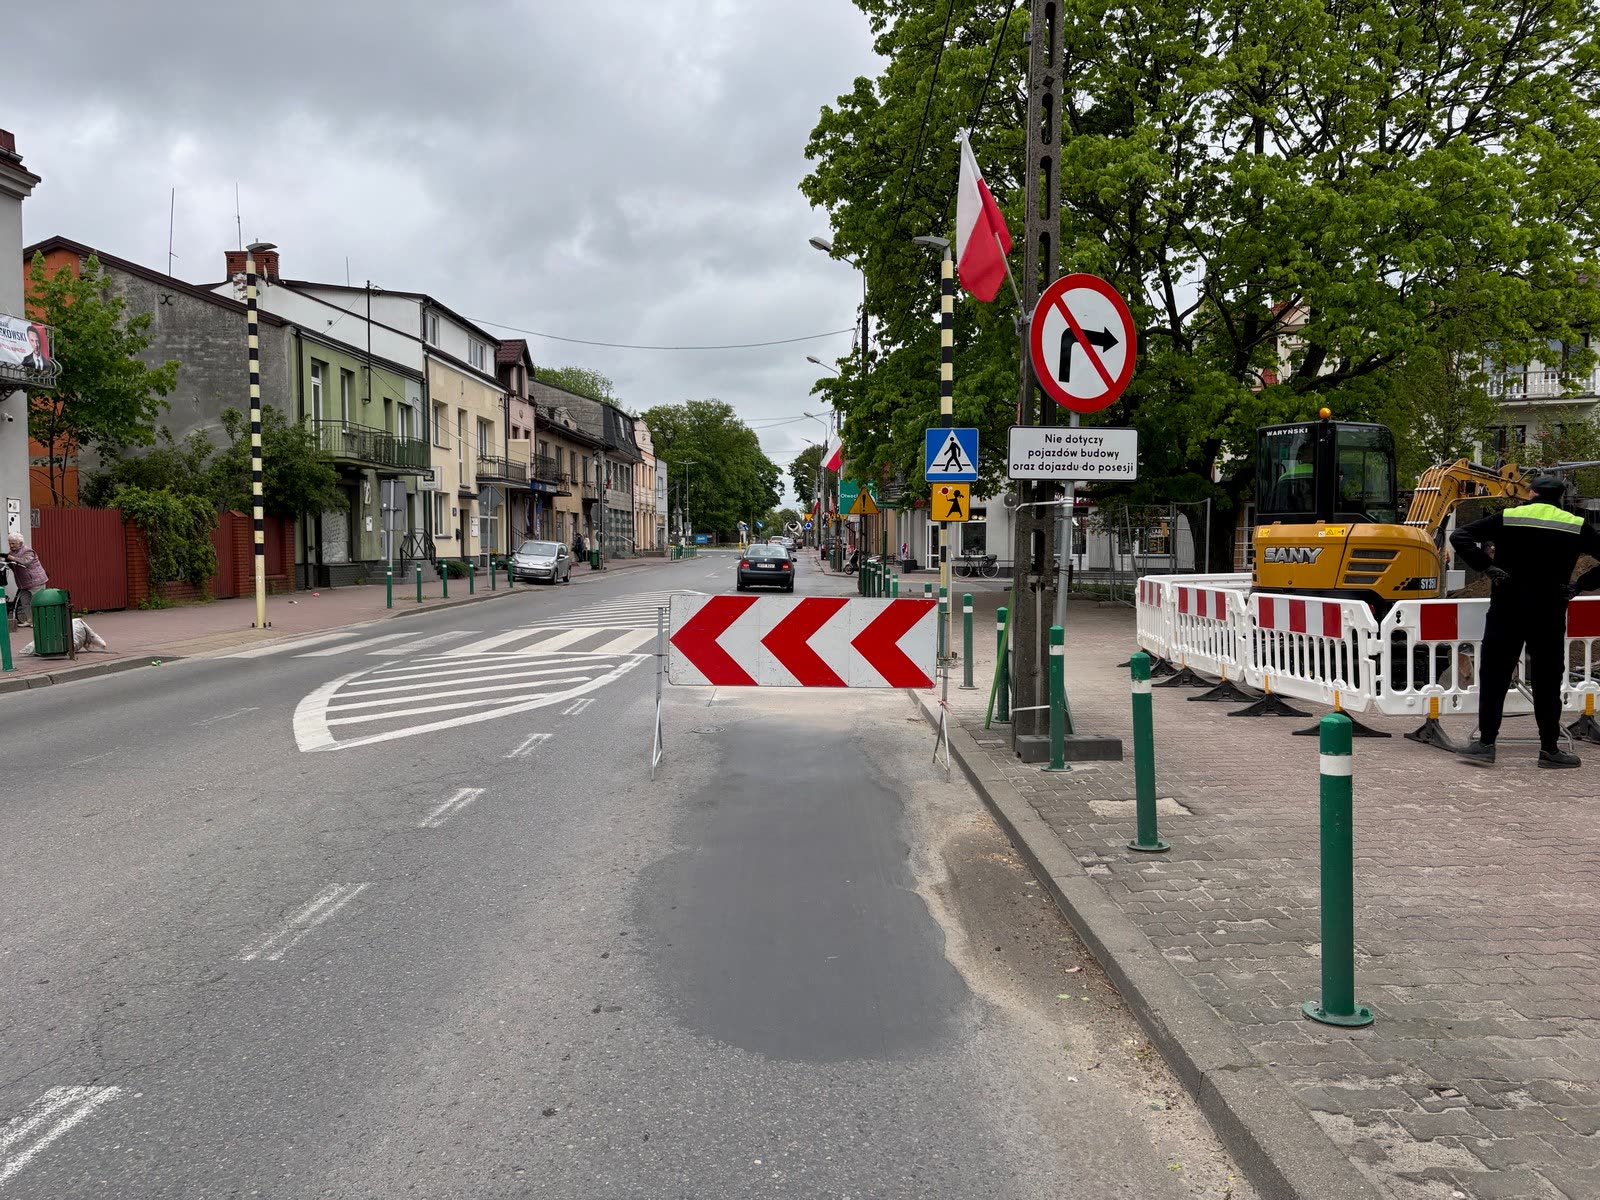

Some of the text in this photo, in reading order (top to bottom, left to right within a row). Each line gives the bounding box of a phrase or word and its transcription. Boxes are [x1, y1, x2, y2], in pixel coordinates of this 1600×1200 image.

[1266, 427, 1308, 437] WARYŃSKI
[1045, 434, 1104, 446] Nie dotyczy
[1028, 448, 1120, 460] pojazdów budowy
[1012, 462, 1134, 474] oraz dojazdu do posesji
[1264, 547, 1324, 564] SANY
